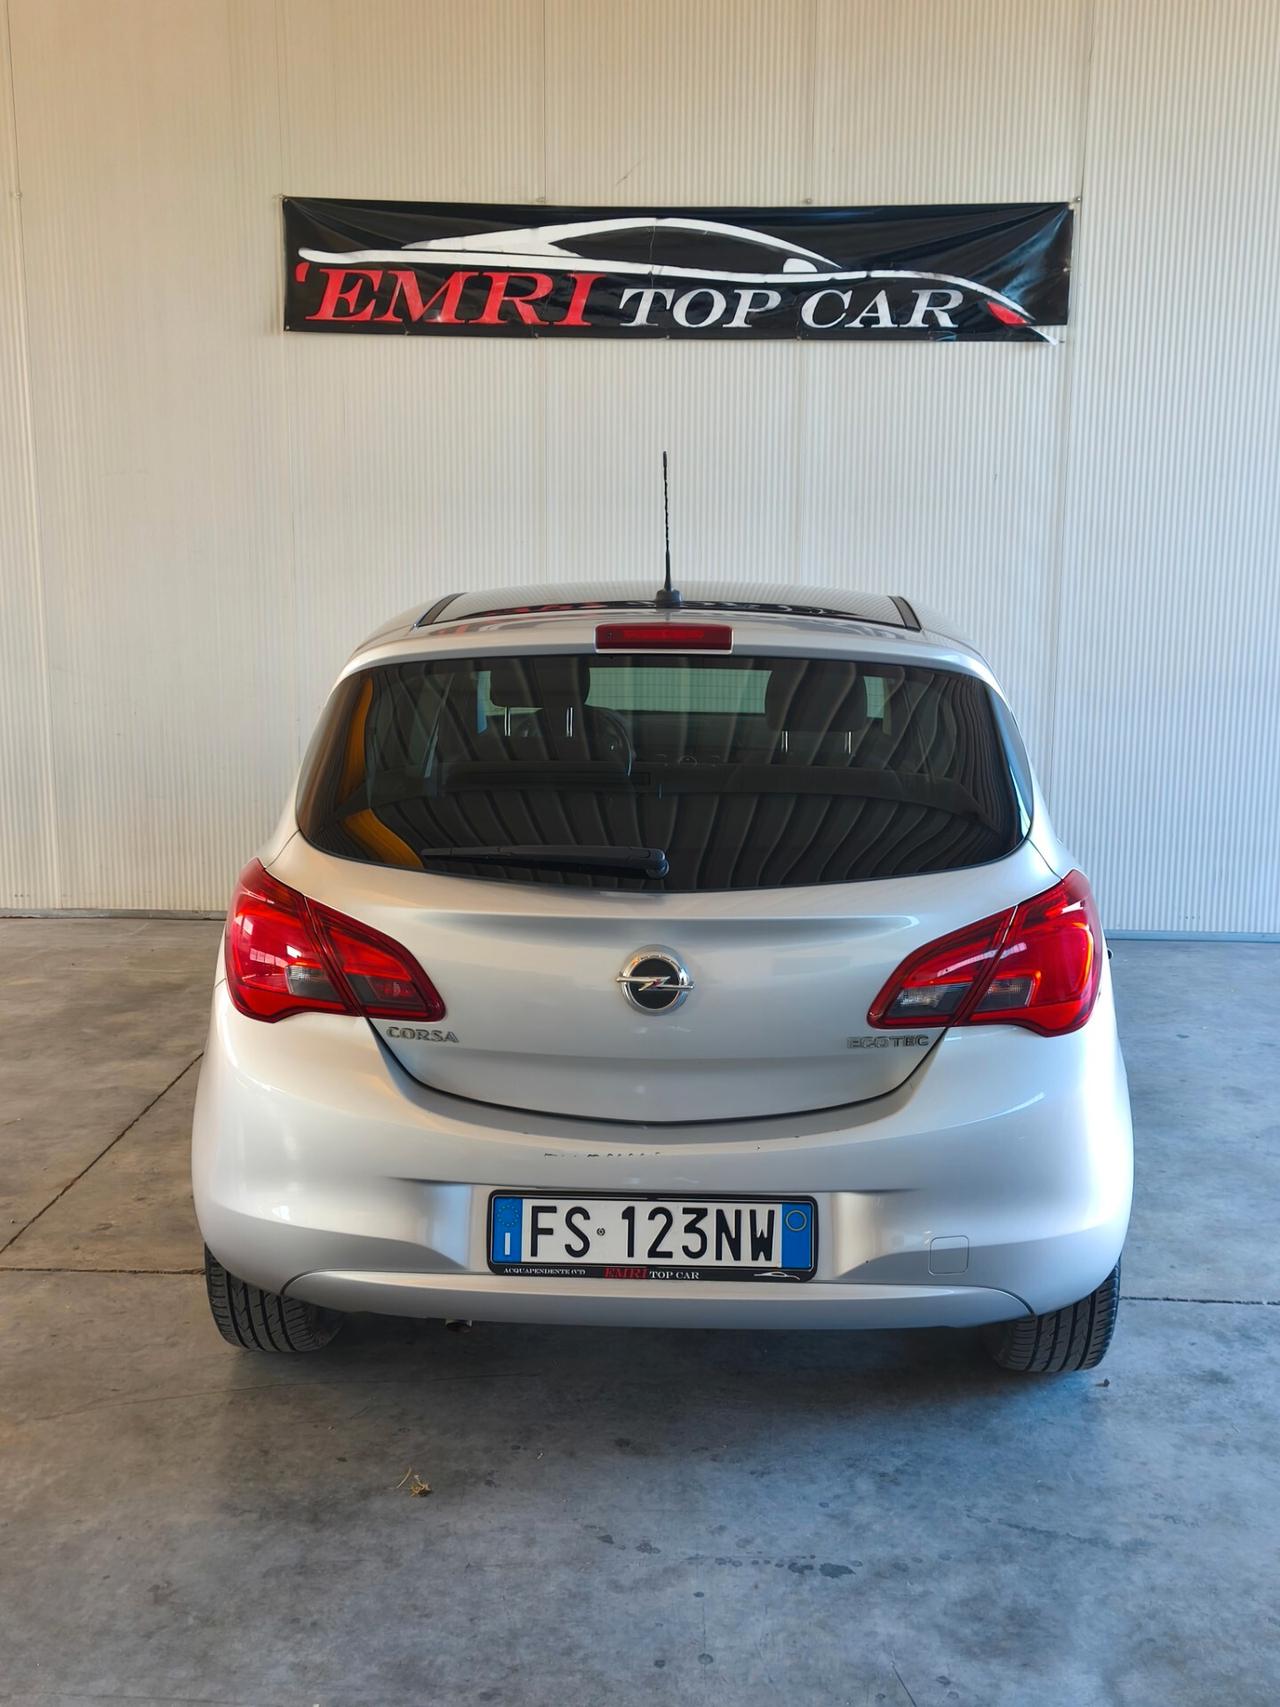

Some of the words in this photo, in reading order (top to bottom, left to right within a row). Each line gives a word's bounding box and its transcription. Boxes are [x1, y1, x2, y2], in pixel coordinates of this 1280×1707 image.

[618, 287, 782, 328] TOP
[801, 289, 964, 329] CAR
[386, 1026, 460, 1043] CORSA
[847, 1034, 929, 1048] ECOTEC
[530, 1205, 591, 1258] FS
[621, 1205, 776, 1262] 123NW
[504, 1231, 511, 1255] I
[503, 1267, 570, 1275] ACQUAPENDENTE
[603, 1266, 648, 1279] EMRI
[649, 1270, 674, 1279] TOP
[675, 1271, 700, 1280] CAR
